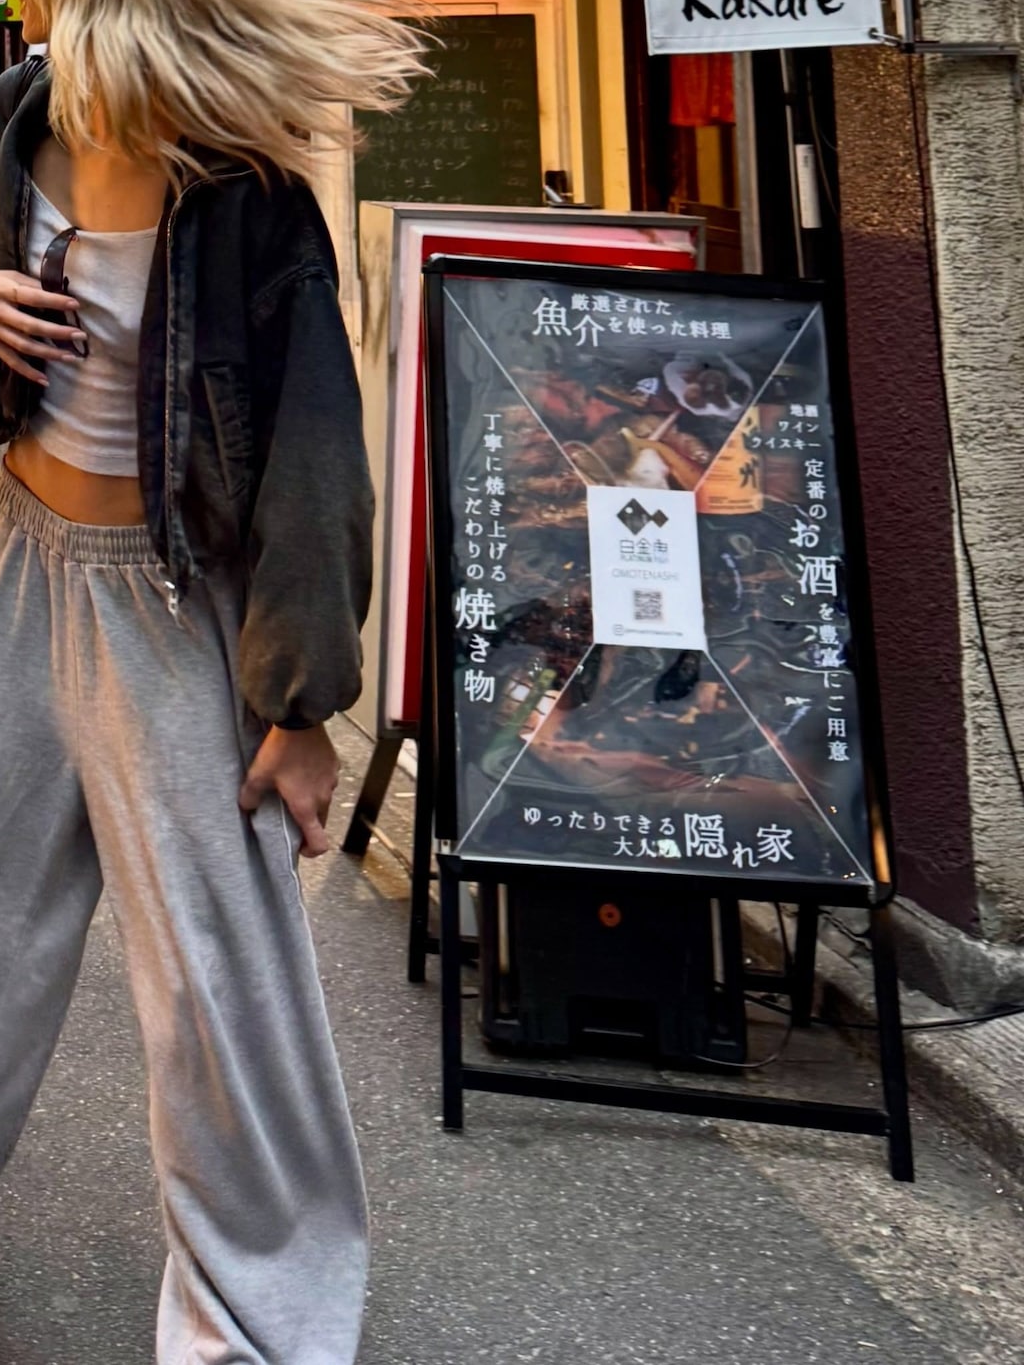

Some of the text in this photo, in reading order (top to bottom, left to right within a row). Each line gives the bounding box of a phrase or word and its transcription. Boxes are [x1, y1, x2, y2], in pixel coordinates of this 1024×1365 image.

[571, 293, 674, 316] 厳選された
[790, 404, 819, 417] 地酒
[778, 421, 820, 433] ワイン
[751, 437, 822, 450] ウイスキー
[482, 413, 508, 583] 丁寧に焼き上げる
[455, 475, 497, 704] こだわりの焼き物
[523, 806, 676, 836] ゆったりできる
